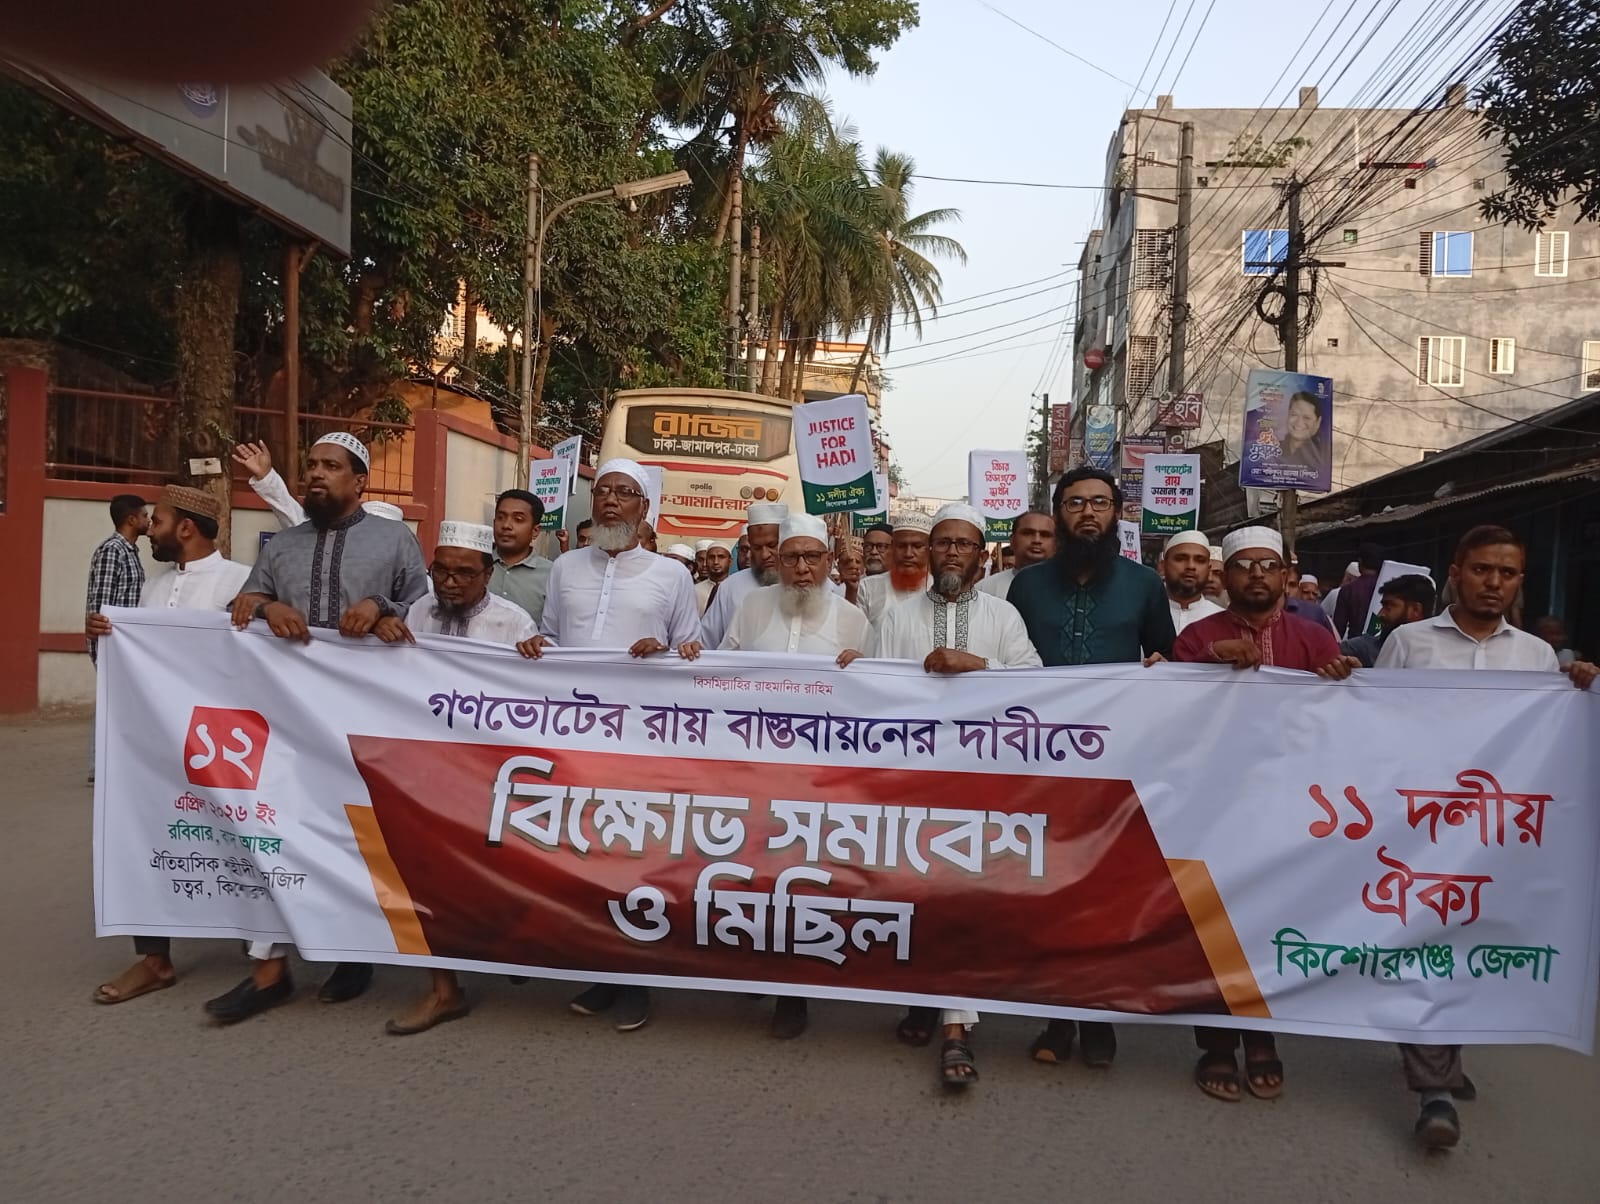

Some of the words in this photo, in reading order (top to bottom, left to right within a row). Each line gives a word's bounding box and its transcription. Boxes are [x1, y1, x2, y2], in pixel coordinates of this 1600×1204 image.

[807, 417, 855, 436] JUSTICE
[653, 438, 759, 457] ঢাকা-জামালপুর-ঢাকা
[821, 435, 846, 450] FOR
[816, 449, 856, 468] HADI
[991, 460, 1010, 471] বিচার
[1155, 464, 1192, 474] গণভোটের
[1164, 476, 1181, 486] রায়
[815, 493, 826, 502] ১১
[693, 675, 751, 692] বিসমিল্লাহির
[754, 678, 800, 696] রাহমানির
[804, 681, 833, 697] রাহিম
[428, 687, 631, 742] গণভোটের
[640, 702, 714, 747] রায়
[724, 707, 944, 758] বাস্তবায়নের
[952, 705, 1111, 764] দাবীতে
[189, 722, 254, 782] ১২
[209, 801, 248, 824] ২০২৬
[256, 800, 276, 825] ইং
[487, 755, 750, 856] বিক্ষোভ
[768, 798, 1048, 879] সমাবেশ
[1308, 784, 1374, 840] ১১
[1396, 769, 1554, 847] দলীয়
[239, 834, 284, 856] আছর
[149, 849, 221, 873] ঐতিহাসিক
[1361, 845, 1494, 927] ঐক্য
[607, 885, 672, 943] ও
[693, 861, 915, 965] মিছিল
[1270, 927, 1456, 981] কিশোরগঞ্জ
[1467, 944, 1560, 984] জেলা
